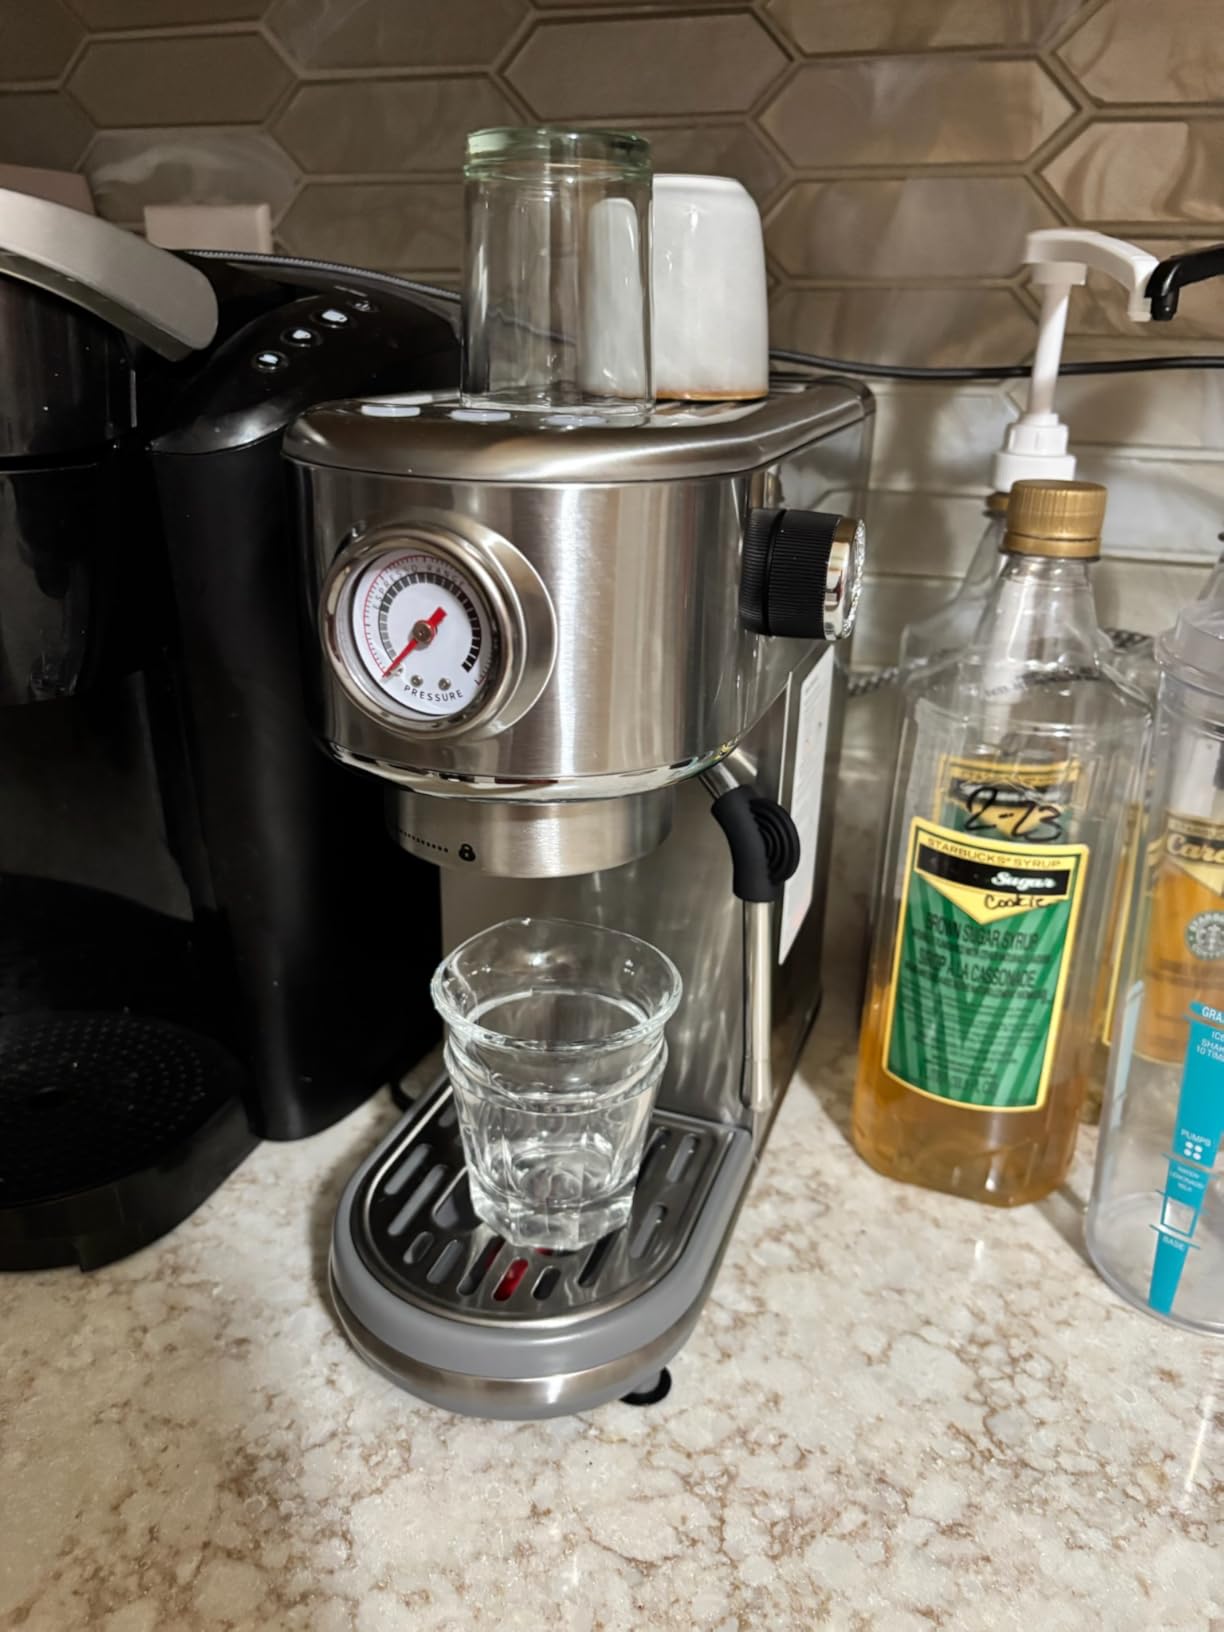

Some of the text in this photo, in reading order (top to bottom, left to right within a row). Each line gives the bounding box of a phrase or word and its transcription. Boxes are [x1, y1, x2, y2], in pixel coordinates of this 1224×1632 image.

[372, 564, 418, 610] ESPRESSO
[404, 684, 464, 702] PRESSURE
[1013, 857, 1062, 868] SYRUP
[991, 871, 1056, 891] Sugar
[984, 892, 1048, 910] Cookie
[1181, 1128, 1212, 1147] PUMPS
